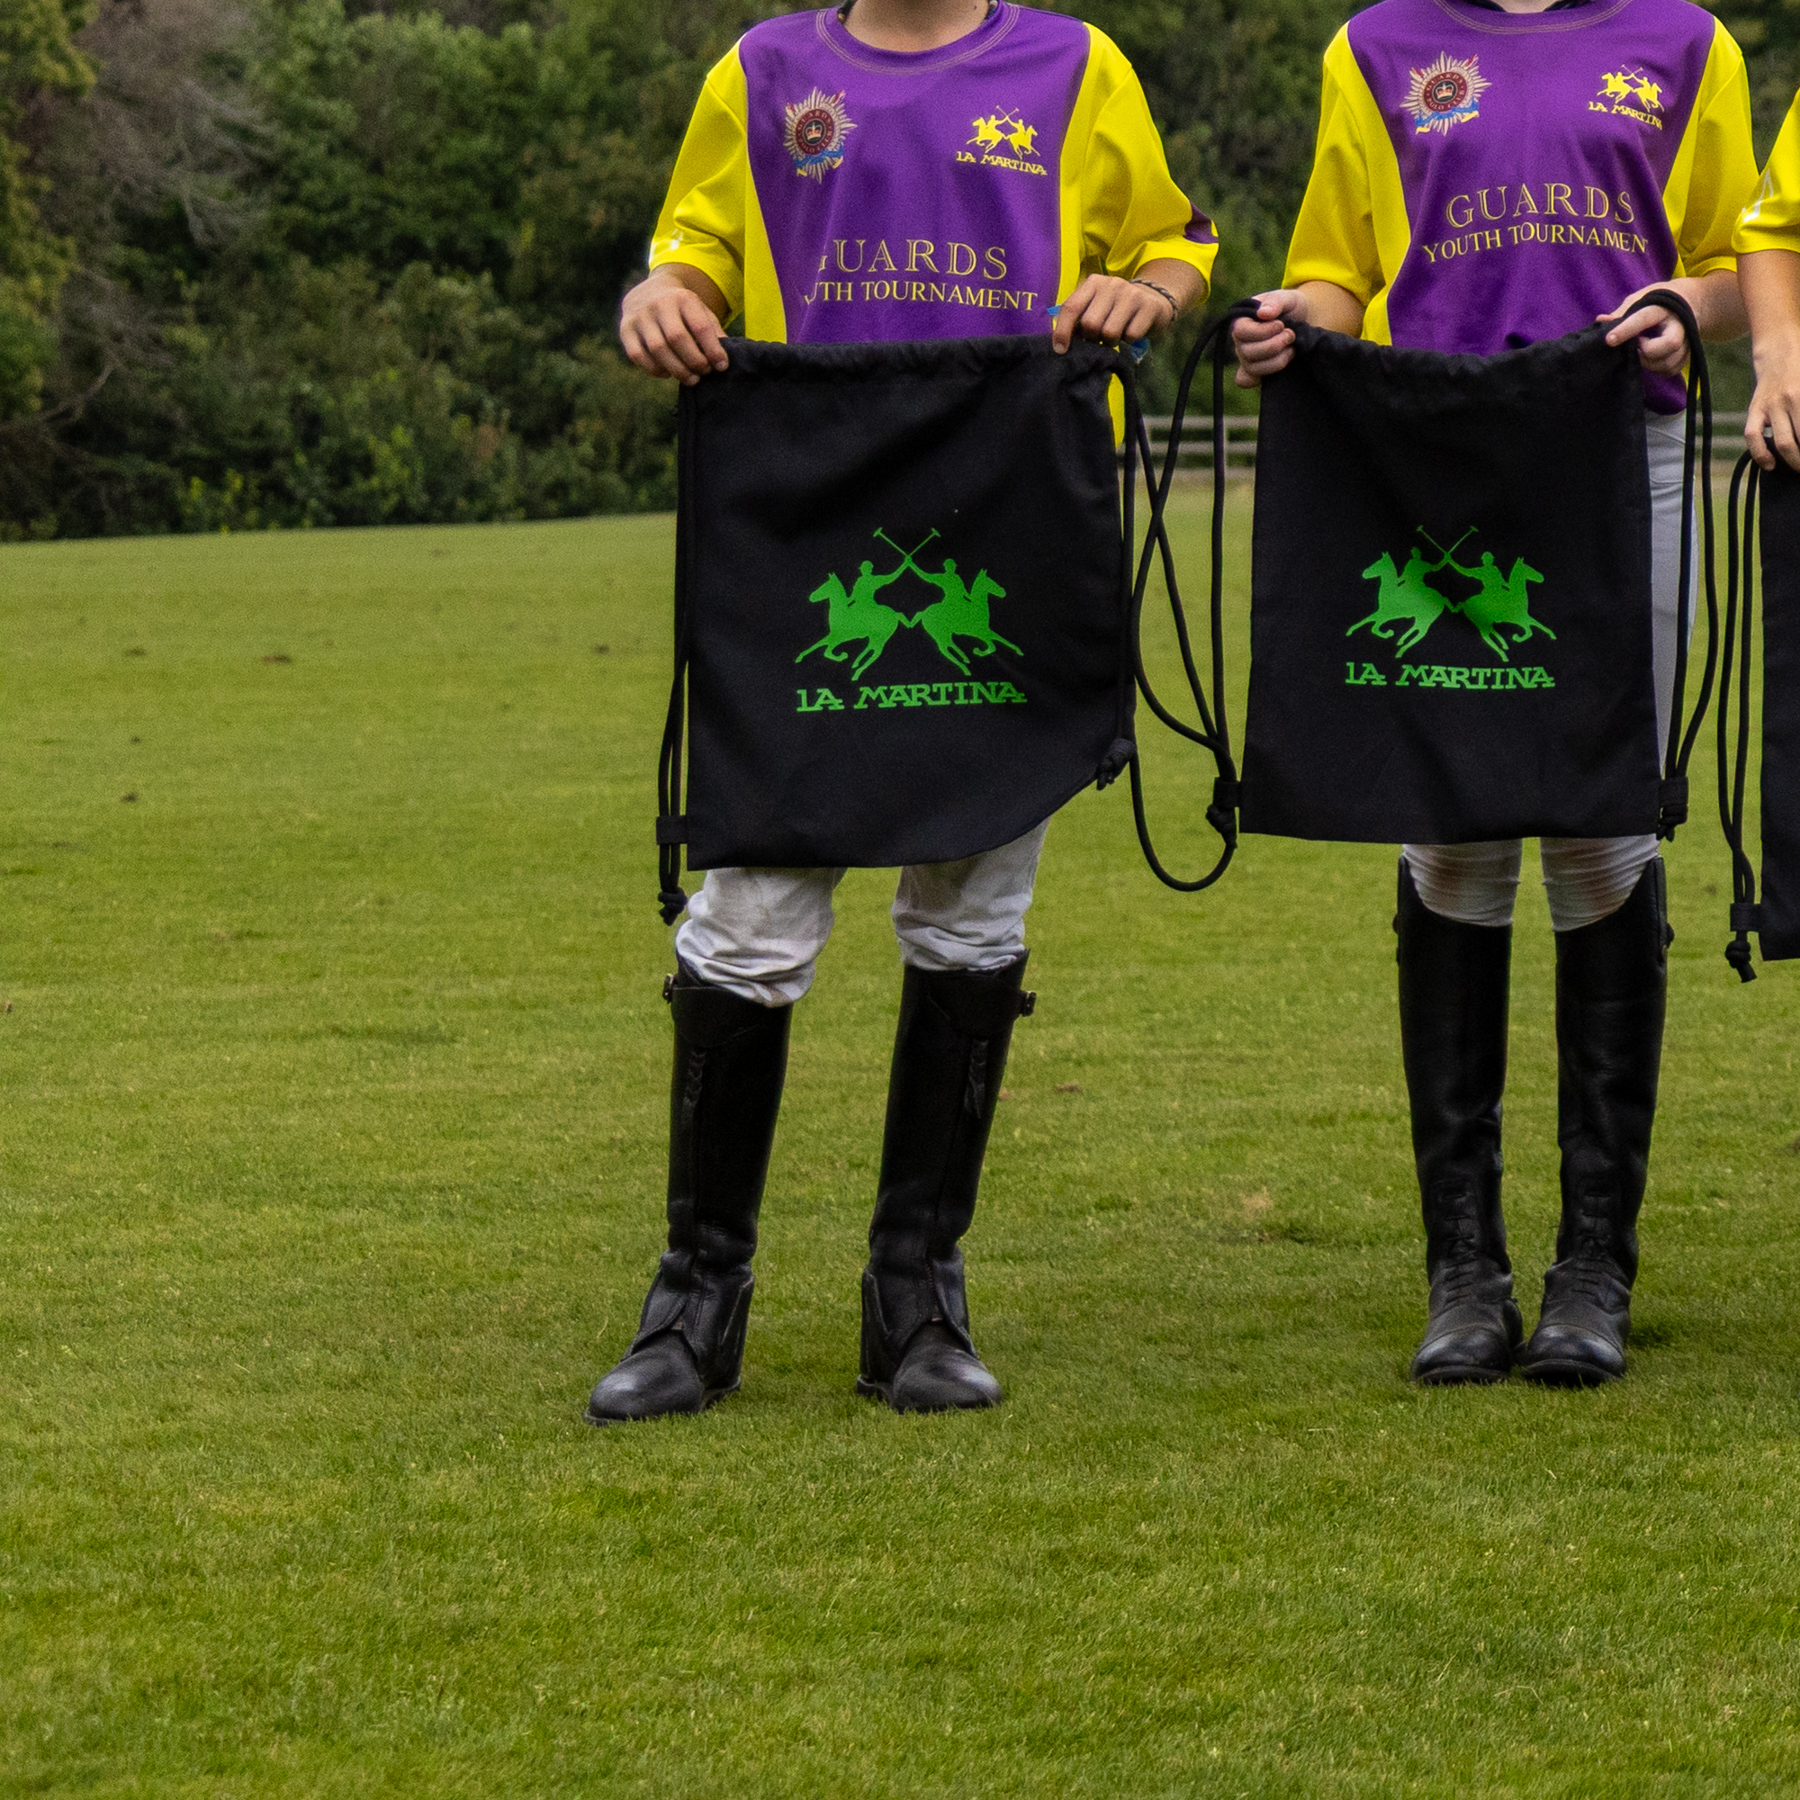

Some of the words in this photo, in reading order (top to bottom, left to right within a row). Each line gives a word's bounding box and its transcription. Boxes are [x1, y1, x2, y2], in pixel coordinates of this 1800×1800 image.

[1588, 101, 1607, 113] LA
[956, 151, 977, 164] LA
[980, 154, 1048, 176] MARTINA
[1445, 182, 1635, 229] GUARDS
[1422, 230, 1502, 264] YOUTH
[1508, 222, 1649, 254] TOURNAMEN
[819, 238, 1008, 281] UARDS
[861, 280, 1038, 311] TOURNAMENT
[1345, 662, 1387, 686] LA
[1395, 664, 1556, 690] MARTINA
[796, 688, 845, 712] LA
[853, 681, 1028, 710] MARTINA
